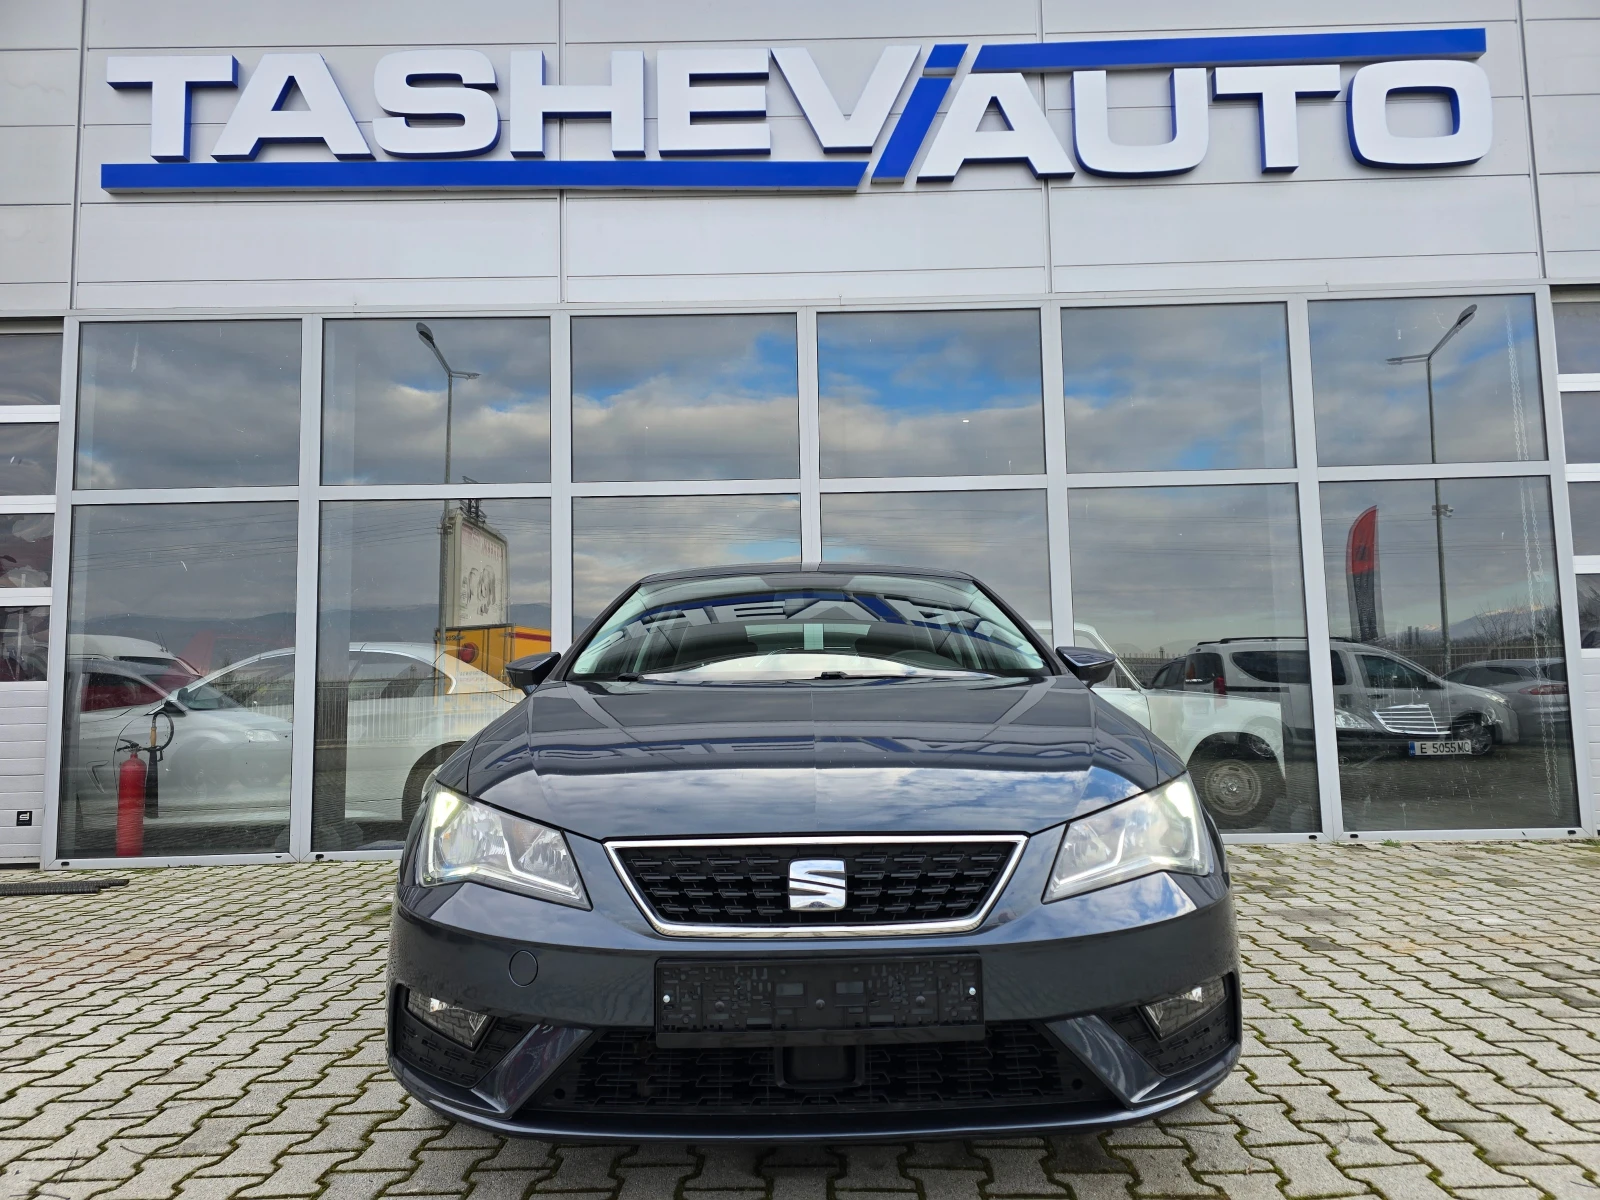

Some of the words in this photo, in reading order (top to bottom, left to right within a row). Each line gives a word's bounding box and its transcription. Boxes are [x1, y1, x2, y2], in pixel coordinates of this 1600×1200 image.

[106, 46, 921, 162] TASHEV
[917, 59, 1493, 183] AUTO
[1420, 743, 1428, 754] E
